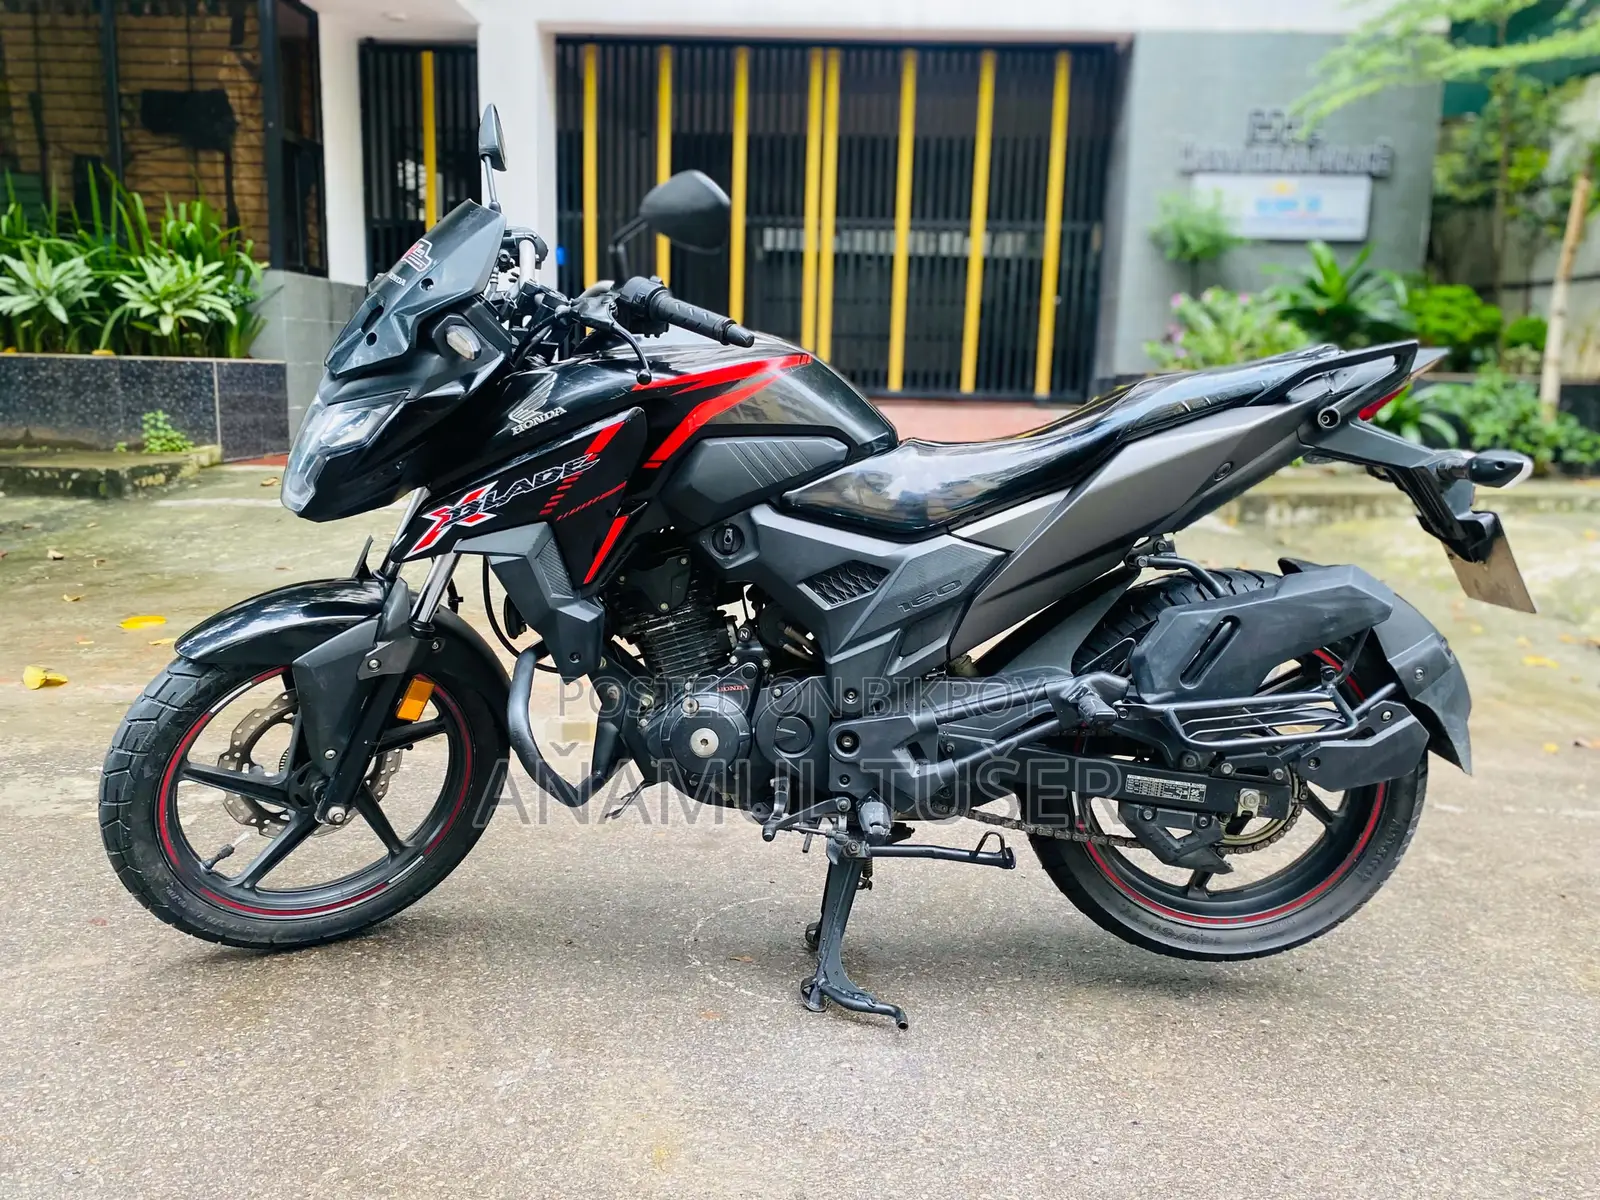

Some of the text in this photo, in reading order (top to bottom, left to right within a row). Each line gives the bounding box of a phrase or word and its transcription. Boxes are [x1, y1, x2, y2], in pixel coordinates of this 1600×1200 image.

[510, 406, 568, 436] HONDA
[897, 579, 963, 613] 160
[716, 683, 749, 693] HONDA
